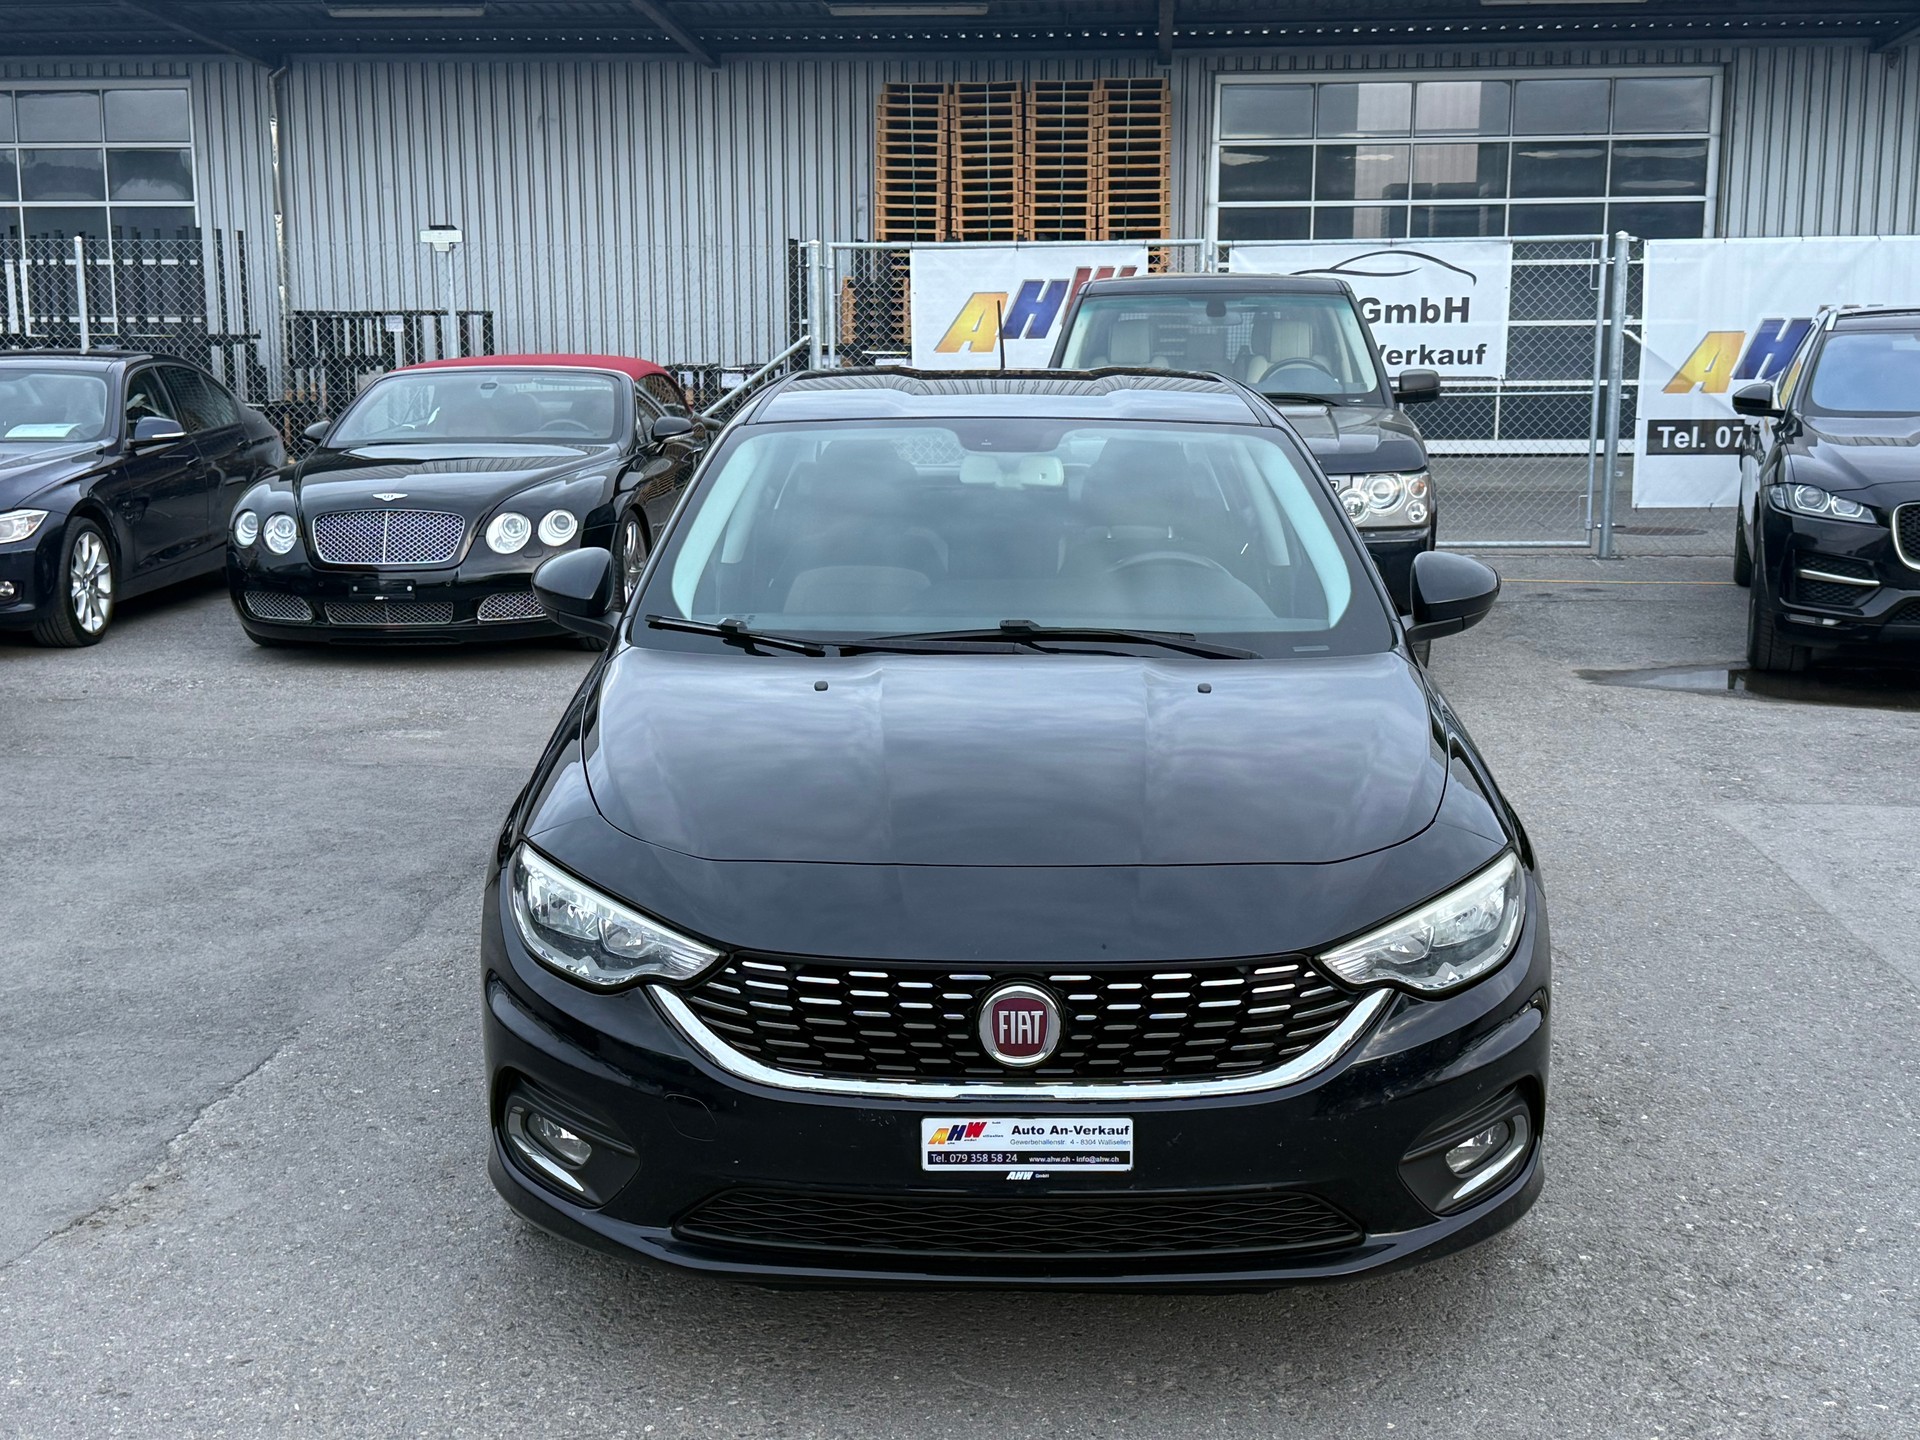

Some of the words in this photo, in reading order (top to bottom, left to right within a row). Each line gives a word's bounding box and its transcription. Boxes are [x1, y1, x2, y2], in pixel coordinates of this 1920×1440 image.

[1358, 297, 1470, 324] GmbH
[1657, 426, 1706, 448] Tel.
[998, 1010, 1044, 1045] FIAT
[927, 1121, 988, 1145] AHW
[1011, 1125, 1045, 1135] Auto
[1049, 1125, 1130, 1135] An-Verkauf
[1080, 1138, 1096, 1146] 8304
[1098, 1138, 1131, 1146] Wallisellen
[931, 1153, 947, 1163] Tel.
[949, 1153, 968, 1163] 079
[970, 1153, 989, 1163] 358
[991, 1153, 1003, 1163] 58
[1005, 1153, 1018, 1163] 24
[1029, 1155, 1071, 1163] www.ahw.ch
[1076, 1155, 1120, 1164] info@ahw.ch
[1006, 1171, 1034, 1180] AHW
